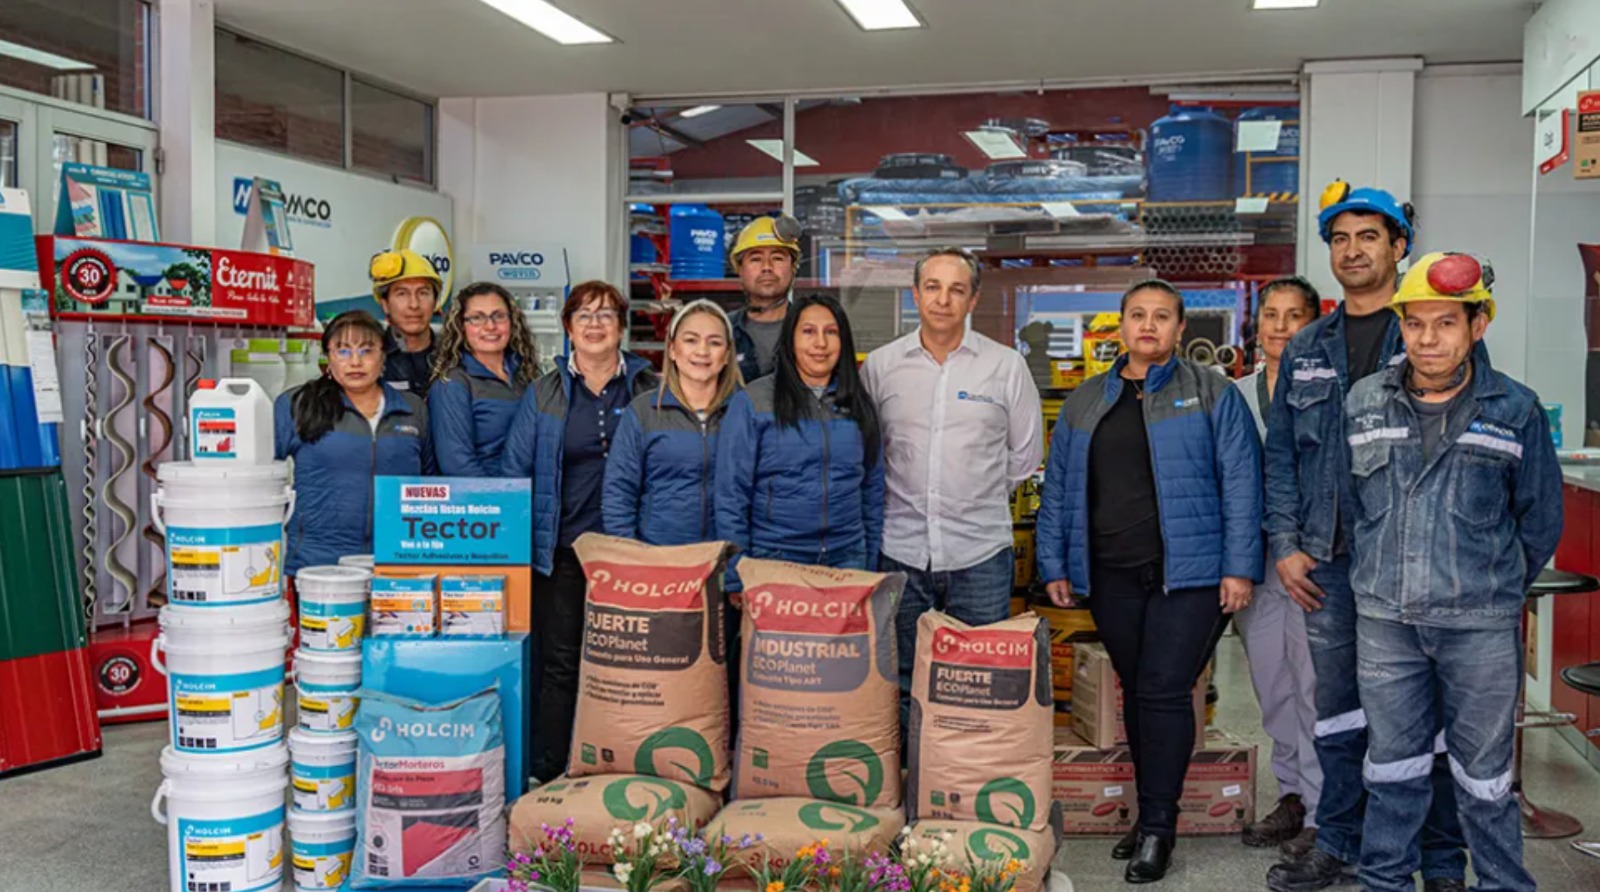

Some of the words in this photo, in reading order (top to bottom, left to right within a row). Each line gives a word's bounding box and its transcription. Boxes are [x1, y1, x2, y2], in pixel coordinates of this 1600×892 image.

[489, 252, 543, 265] PAVCO
[79, 268, 100, 284] 30
[216, 256, 279, 291] Eternit
[405, 486, 447, 498] NUEVAS
[402, 517, 500, 539] Tector
[612, 578, 702, 597] HOLCIM
[775, 600, 862, 618] HOLCIM
[588, 611, 650, 634] FUERTE
[755, 638, 860, 658] INDUSTRIAL
[958, 641, 1029, 656] HOLCIM
[109, 666, 129, 680] 30
[937, 667, 993, 685] FUERTE
[396, 723, 475, 737] HOLCIM
